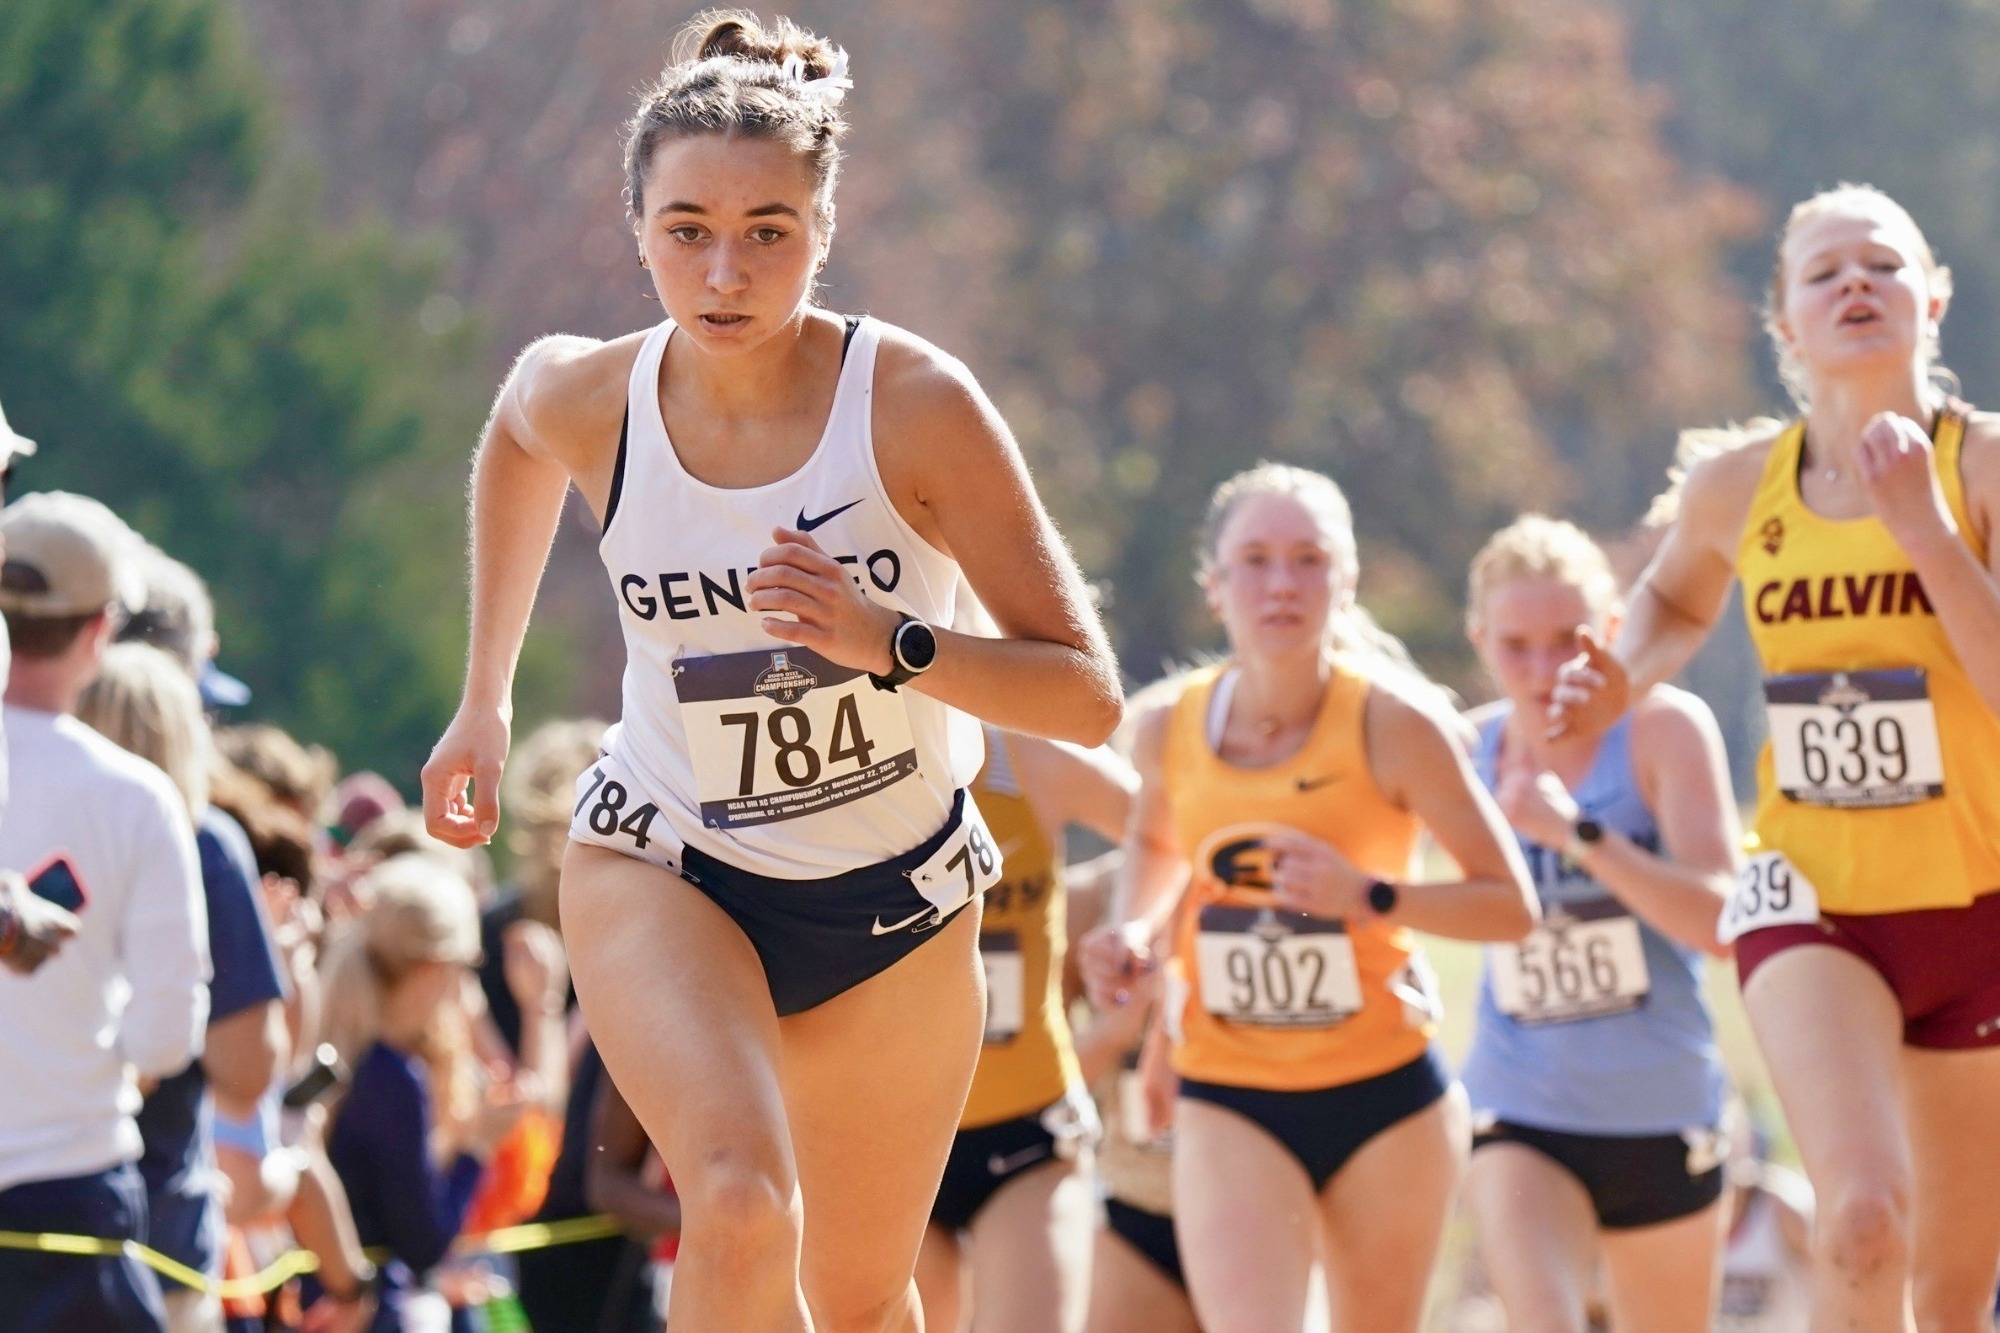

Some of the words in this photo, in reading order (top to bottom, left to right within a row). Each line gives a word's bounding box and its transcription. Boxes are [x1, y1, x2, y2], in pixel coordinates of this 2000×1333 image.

[755, 677, 815, 692] CHAMPIONSHIPS
[720, 693, 875, 797] 784
[1800, 717, 1909, 786] 639
[574, 766, 660, 850] 784
[727, 801, 746, 811] NCAA
[759, 798, 769, 807] XC
[769, 787, 823, 805] CHAMPIONSHIPS
[831, 773, 866, 790] November
[866, 769, 879, 779] 22,
[879, 760, 896, 774] 2025
[804, 795, 831, 808] Research
[830, 791, 844, 801] Park
[843, 786, 860, 796] Cross
[860, 778, 882, 791] Country
[881, 769, 900, 783] Course
[1732, 857, 1791, 921] 39
[1227, 947, 1330, 1011] 902
[1518, 936, 1619, 1005] 566
